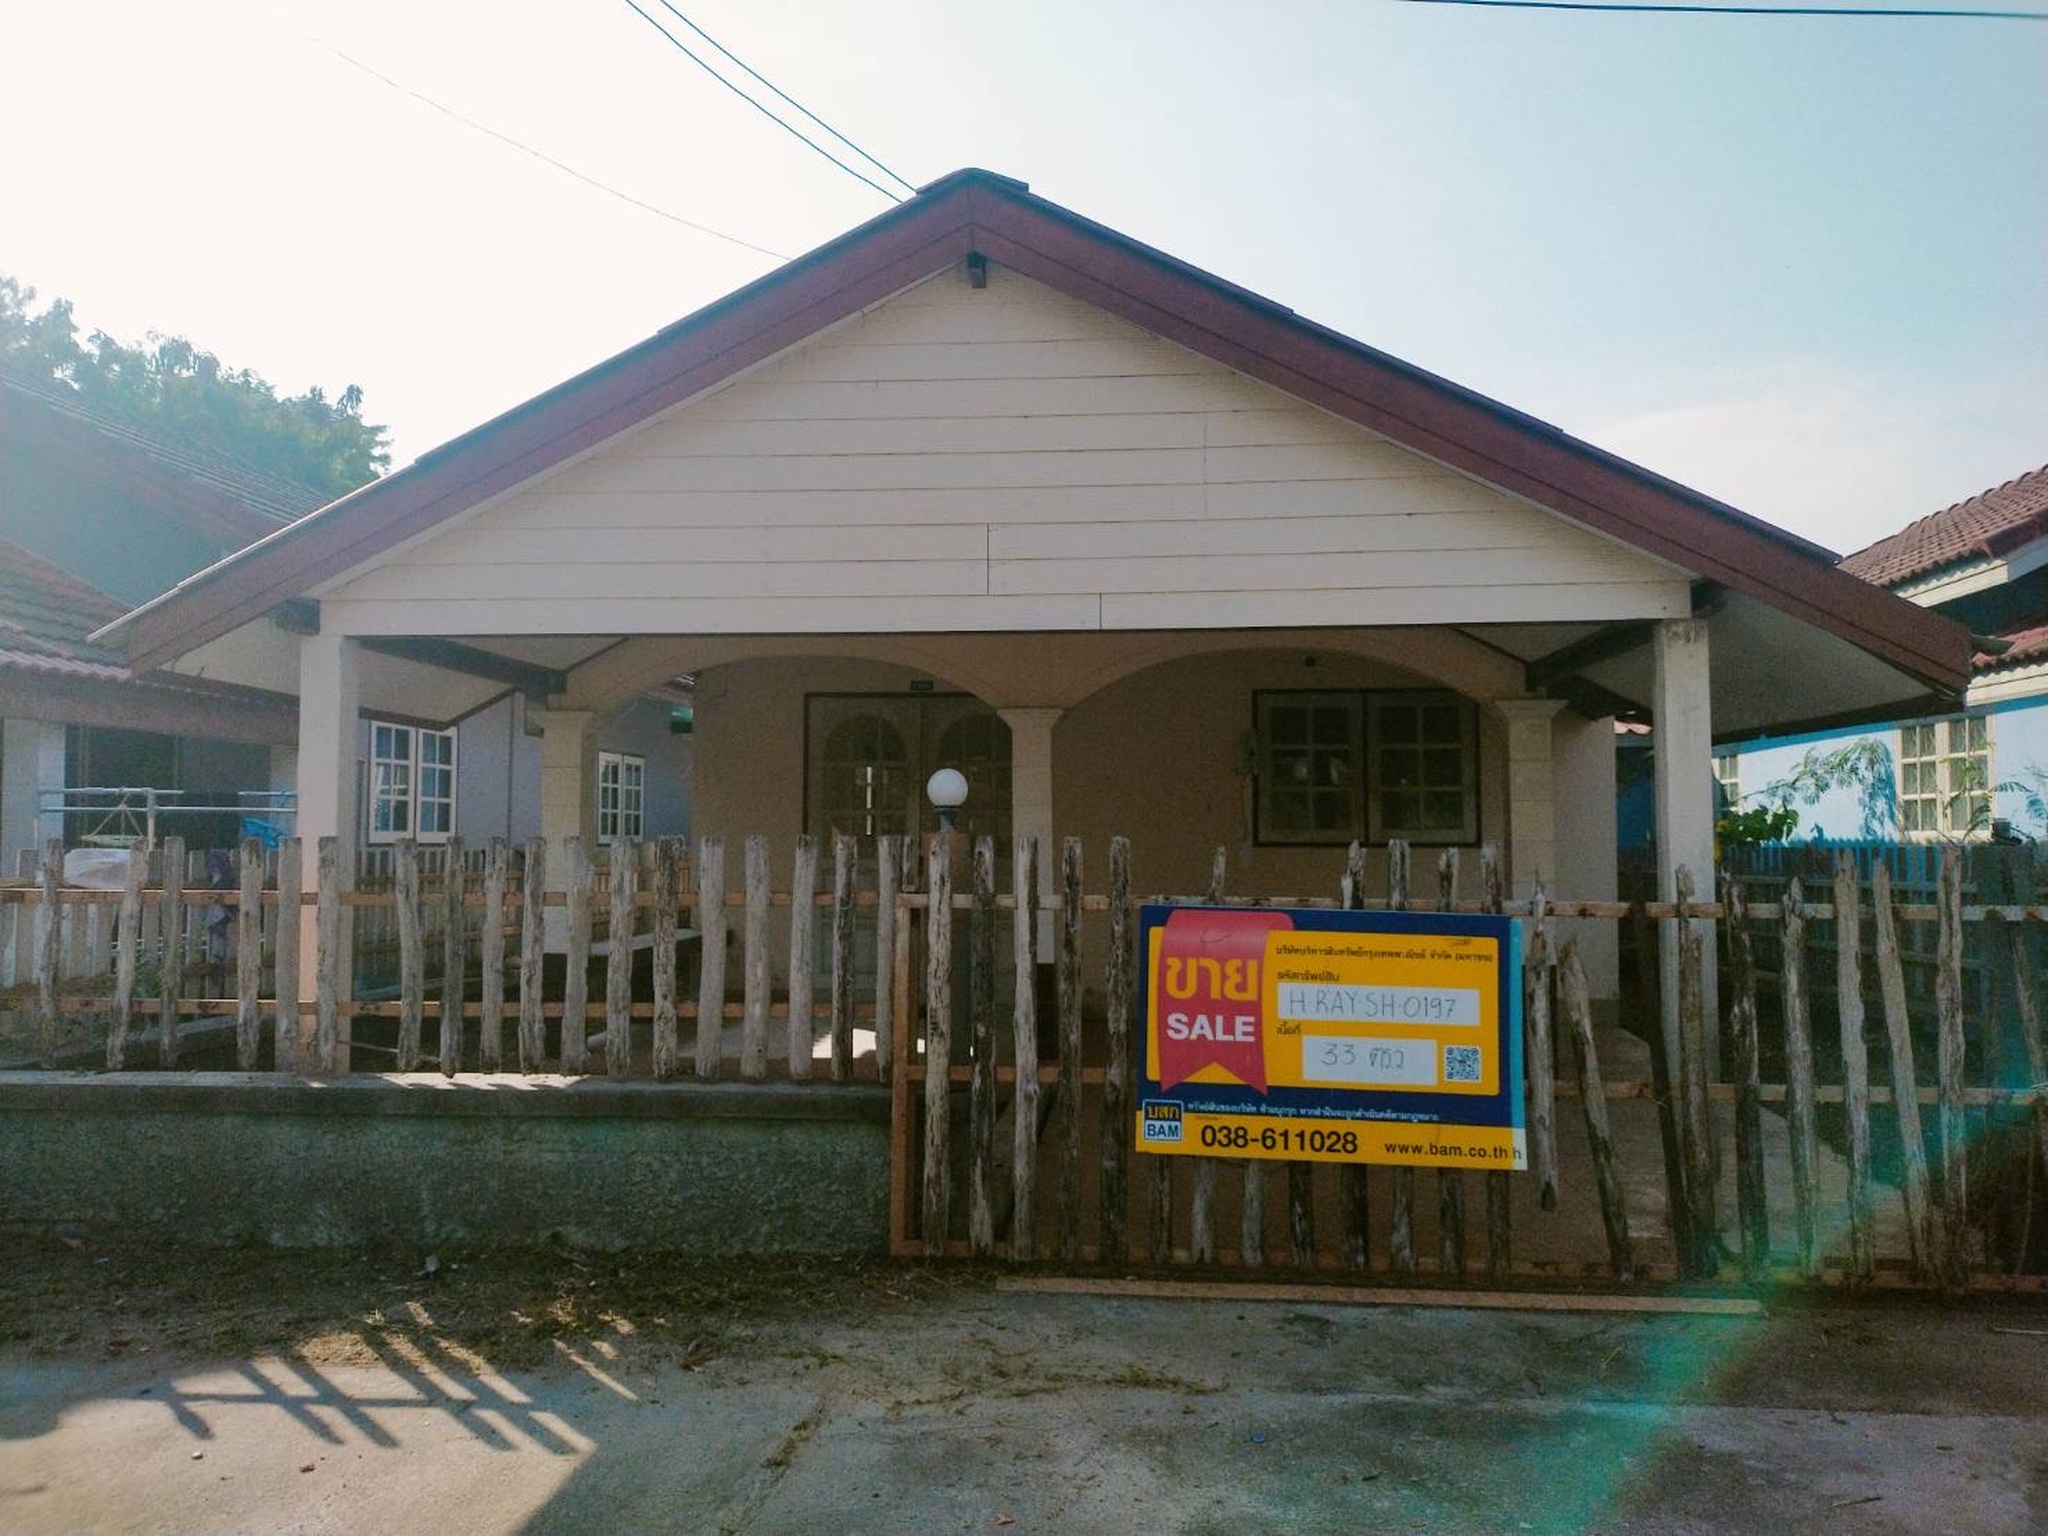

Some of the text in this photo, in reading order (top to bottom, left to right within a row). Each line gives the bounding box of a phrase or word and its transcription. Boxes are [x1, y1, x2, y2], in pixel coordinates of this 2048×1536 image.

[1165, 957, 1258, 1001] ขาย
[1166, 1012, 1255, 1042] SALE
[1320, 1042, 1356, 1066] 33
[1147, 1123, 1179, 1138] BAM
[1201, 1125, 1358, 1154] 038-611028
[1384, 1142, 1508, 1159] www.bam.co.th
